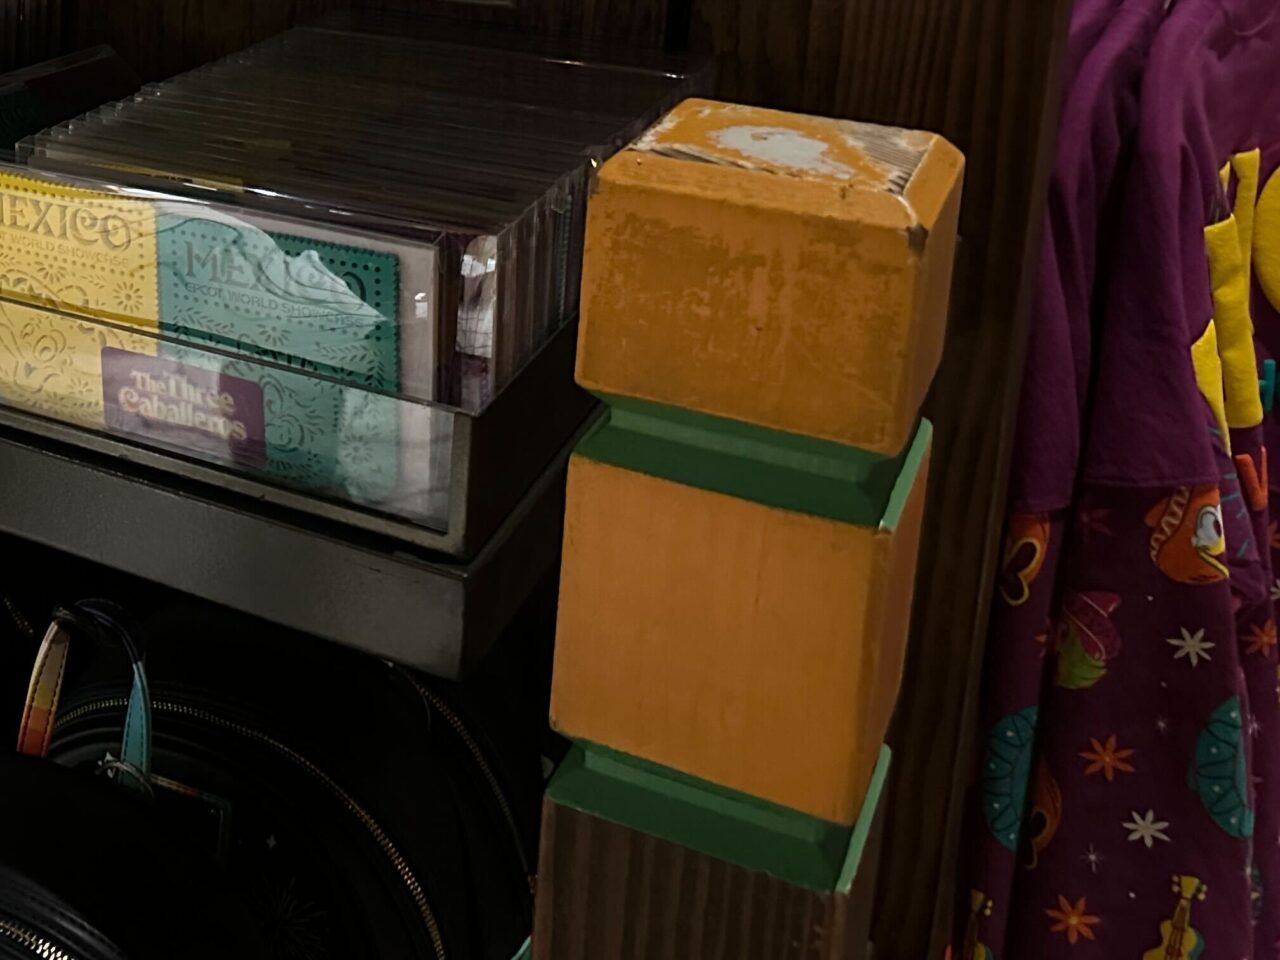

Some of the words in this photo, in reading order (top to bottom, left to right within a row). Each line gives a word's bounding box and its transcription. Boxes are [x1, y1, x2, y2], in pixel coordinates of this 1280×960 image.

[10, 231, 56, 253] WORLD
[185, 282, 223, 299] EPCOT
[227, 289, 279, 311] WORLD
[130, 369, 167, 391] The
[163, 370, 235, 414] Three
[118, 386, 247, 441] Caballeros
